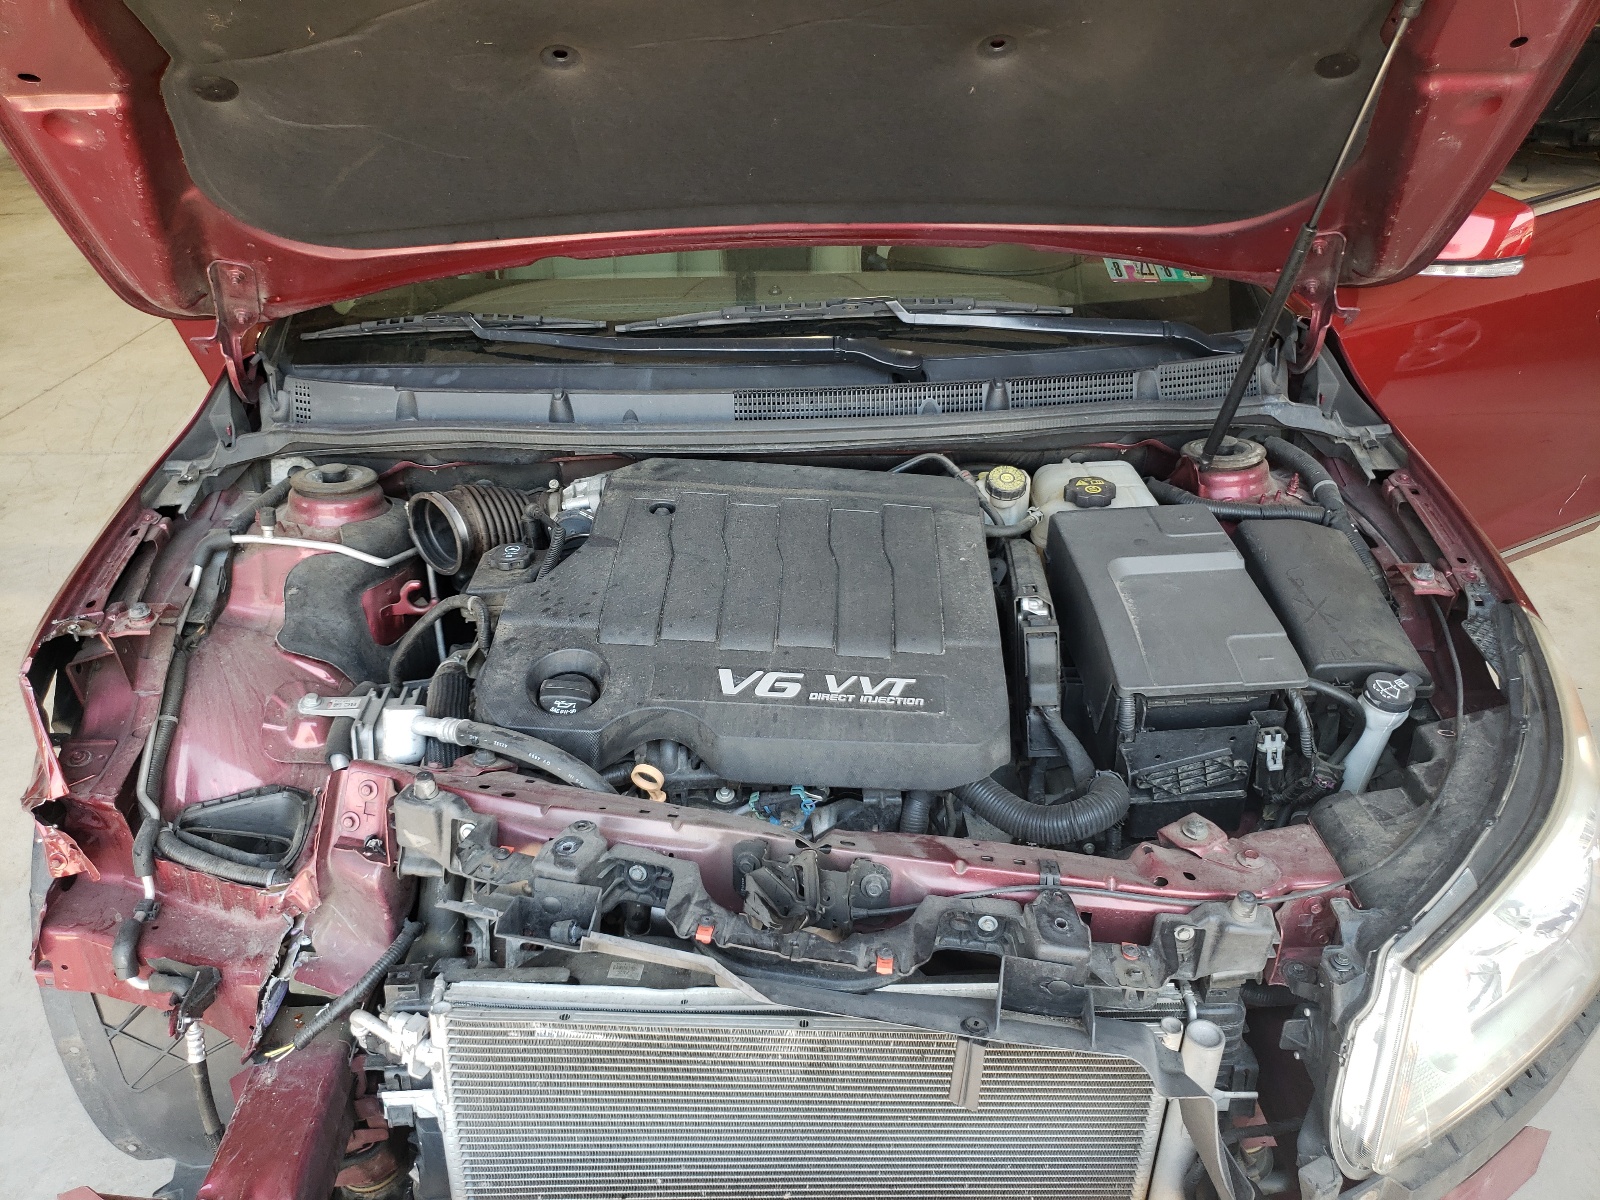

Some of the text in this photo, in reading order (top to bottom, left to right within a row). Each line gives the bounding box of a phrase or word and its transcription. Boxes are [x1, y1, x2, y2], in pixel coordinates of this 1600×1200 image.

[718, 668, 917, 698] V6 VVT
[808, 692, 925, 706] DIRECT INJECTION
